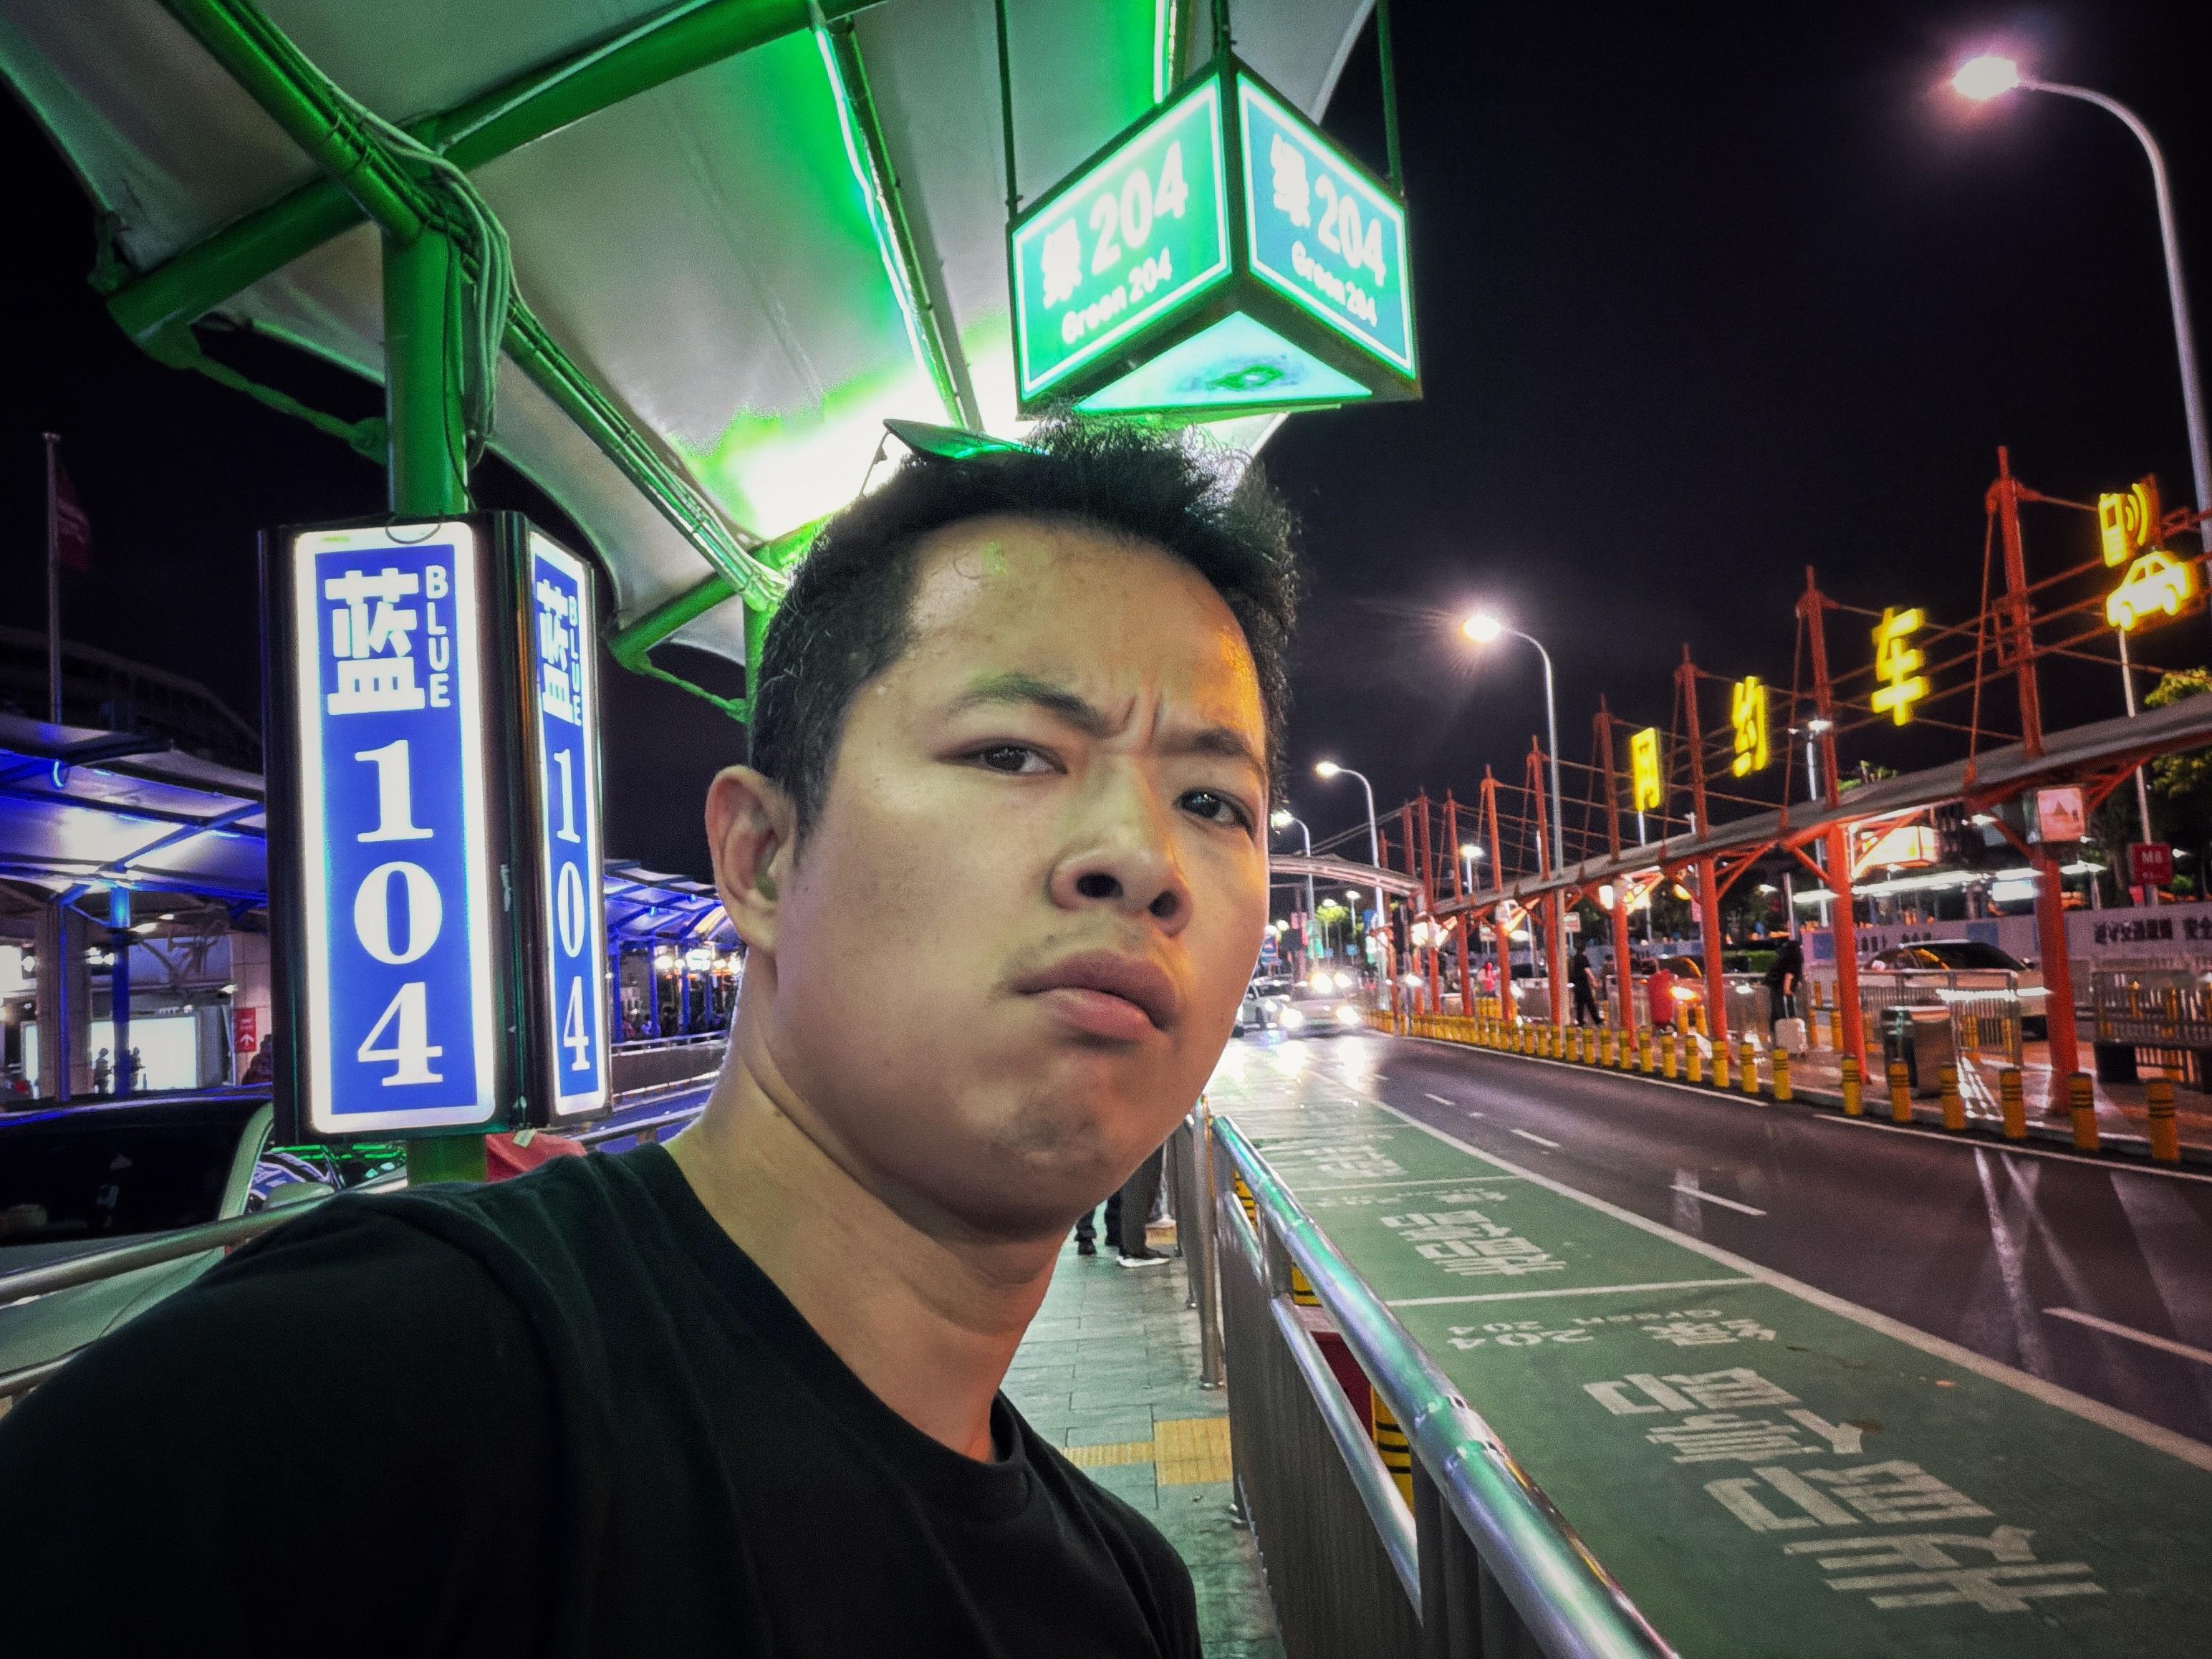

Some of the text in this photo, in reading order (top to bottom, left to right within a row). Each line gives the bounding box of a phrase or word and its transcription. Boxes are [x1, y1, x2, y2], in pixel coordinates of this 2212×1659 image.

[1089, 139, 1189, 276] 204
[1128, 246, 1172, 304] 204
[1314, 173, 1386, 287] 204
[425, 565, 451, 708] BLUE
[568, 596, 582, 726] BLUE
[354, 739, 443, 1087] 104
[553, 749, 590, 1072] 104
